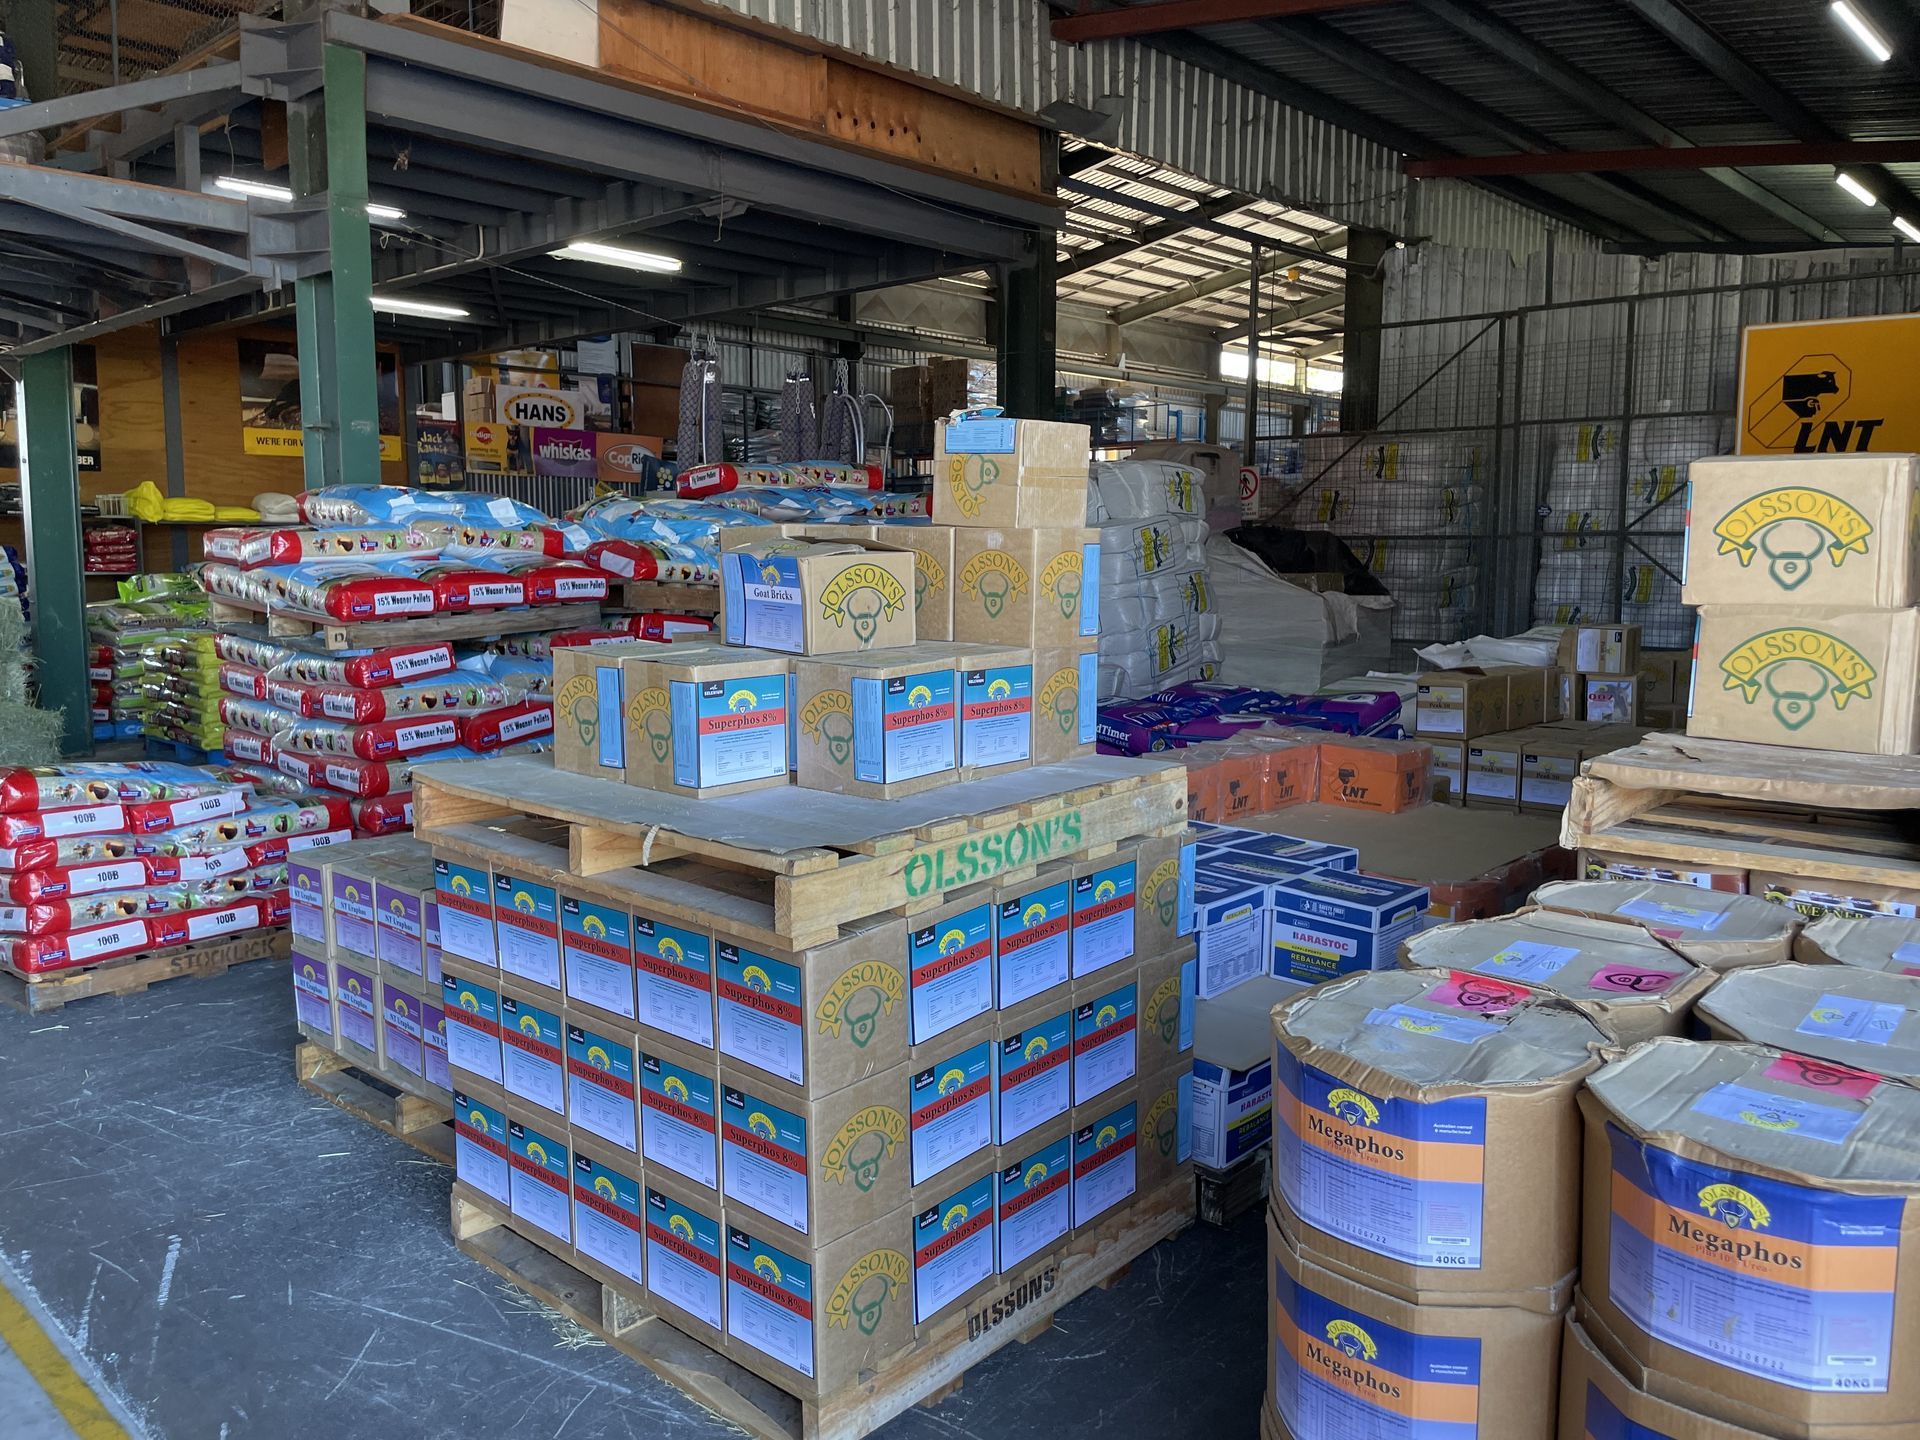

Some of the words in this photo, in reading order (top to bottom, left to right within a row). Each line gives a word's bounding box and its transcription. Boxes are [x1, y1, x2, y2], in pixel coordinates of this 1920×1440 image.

[515, 402, 566, 422] HANS
[283, 438, 298, 447] FOR
[417, 441, 448, 454] Rabbit
[420, 431, 442, 444] Jack
[1794, 418, 1884, 453] LNT
[539, 445, 592, 462] whiskas
[1726, 493, 1862, 538] OLSSON'S
[964, 553, 1024, 585] OLSSON'S
[1043, 554, 1082, 586] OLSSO
[391, 593, 412, 605] Weaner
[413, 592, 431, 604] Pellets
[485, 586, 504, 596] Weaner
[504, 584, 522, 595] Pellets
[571, 581, 588, 590] Weaner
[589, 580, 606, 590] Pellets
[754, 587, 770, 599] Goat
[772, 587, 793, 601] Bricks
[826, 567, 901, 606] OLSSON'S
[408, 656, 428, 667] Weaner
[430, 652, 448, 664] Pellets
[1732, 632, 1864, 681] OLSSON'S
[560, 678, 598, 709] OLSSO
[1042, 672, 1078, 707] OLSSO
[632, 690, 671, 723] OLSSO
[892, 710, 934, 727] Superphos
[934, 706, 948, 719] 8%
[970, 703, 1012, 718] Superphos
[1014, 700, 1025, 712] 8%
[414, 728, 435, 739] Weaner
[436, 724, 454, 736] Pellets
[514, 719, 532, 730] Weaner
[534, 714, 550, 725] Pellets
[708, 714, 760, 730] Superphos
[762, 712, 776, 722] 8%
[200, 798, 222, 810] 100B
[1232, 796, 1249, 810] LNT
[1280, 784, 1294, 799] LNT
[1342, 786, 1368, 799] LNT
[73, 812, 96, 824] 100B
[311, 836, 331, 846] 100B
[904, 811, 1082, 896] OLSSON'S
[97, 870, 120, 882] 100B
[1144, 862, 1180, 900] OLSSO
[216, 912, 236, 926] 100B
[502, 910, 539, 930] Superphos
[1080, 902, 1118, 922] Superphos
[97, 934, 120, 947] 100B
[570, 934, 610, 956] Superphos
[1006, 928, 1048, 950] Superphos
[1050, 920, 1062, 934] 8%
[1292, 931, 1348, 951] BARASTOC
[642, 957, 688, 981] Superphos
[689, 972, 703, 986] 8%
[920, 954, 968, 980] Superphos
[970, 947, 984, 959] 8%
[1290, 952, 1337, 970] REBALANCE
[724, 984, 775, 1013] Superphos
[776, 1001, 793, 1019] 8%
[823, 964, 899, 1018] OLSSON'S
[1147, 980, 1180, 1020] OLSSO
[507, 1032, 543, 1053] Superphos
[1080, 1027, 1118, 1050] Superphos
[574, 1059, 613, 1088] Superphos
[1007, 1059, 1050, 1086] Superphos
[648, 1094, 692, 1122] Superphos
[694, 1112, 708, 1128] 8%
[919, 1092, 968, 1122] Superphos
[969, 1083, 983, 1098] 8%
[1144, 1091, 1178, 1138] OLSSO
[1331, 1090, 1378, 1120] OLSSON'S
[730, 1128, 780, 1161] Superphos
[782, 1150, 798, 1167] 8%
[827, 1109, 902, 1166] OLSSON'S
[1308, 1114, 1404, 1161] Megaphos
[514, 1156, 550, 1182] Superphos
[1080, 1146, 1118, 1172] Superphos
[580, 1190, 620, 1220] Superphos
[1007, 1184, 1050, 1213] Superphos
[1703, 1188, 1767, 1218] OLSSON'S
[654, 1230, 698, 1259] Superphos
[924, 1224, 970, 1260] Superphos
[972, 1216, 986, 1230] 8%
[1668, 1214, 1802, 1270] Megaphos
[1436, 1255, 1466, 1266] 40KG
[736, 1268, 786, 1303] Superphos
[787, 1296, 803, 1312] 8%
[832, 1253, 906, 1312] OLSSON'S
[967, 1267, 1056, 1341] OLSSONS
[1330, 1322, 1376, 1352] OLSSON'S
[1306, 1341, 1401, 1400] Megaphos
[1835, 1378, 1872, 1389] 40KG
